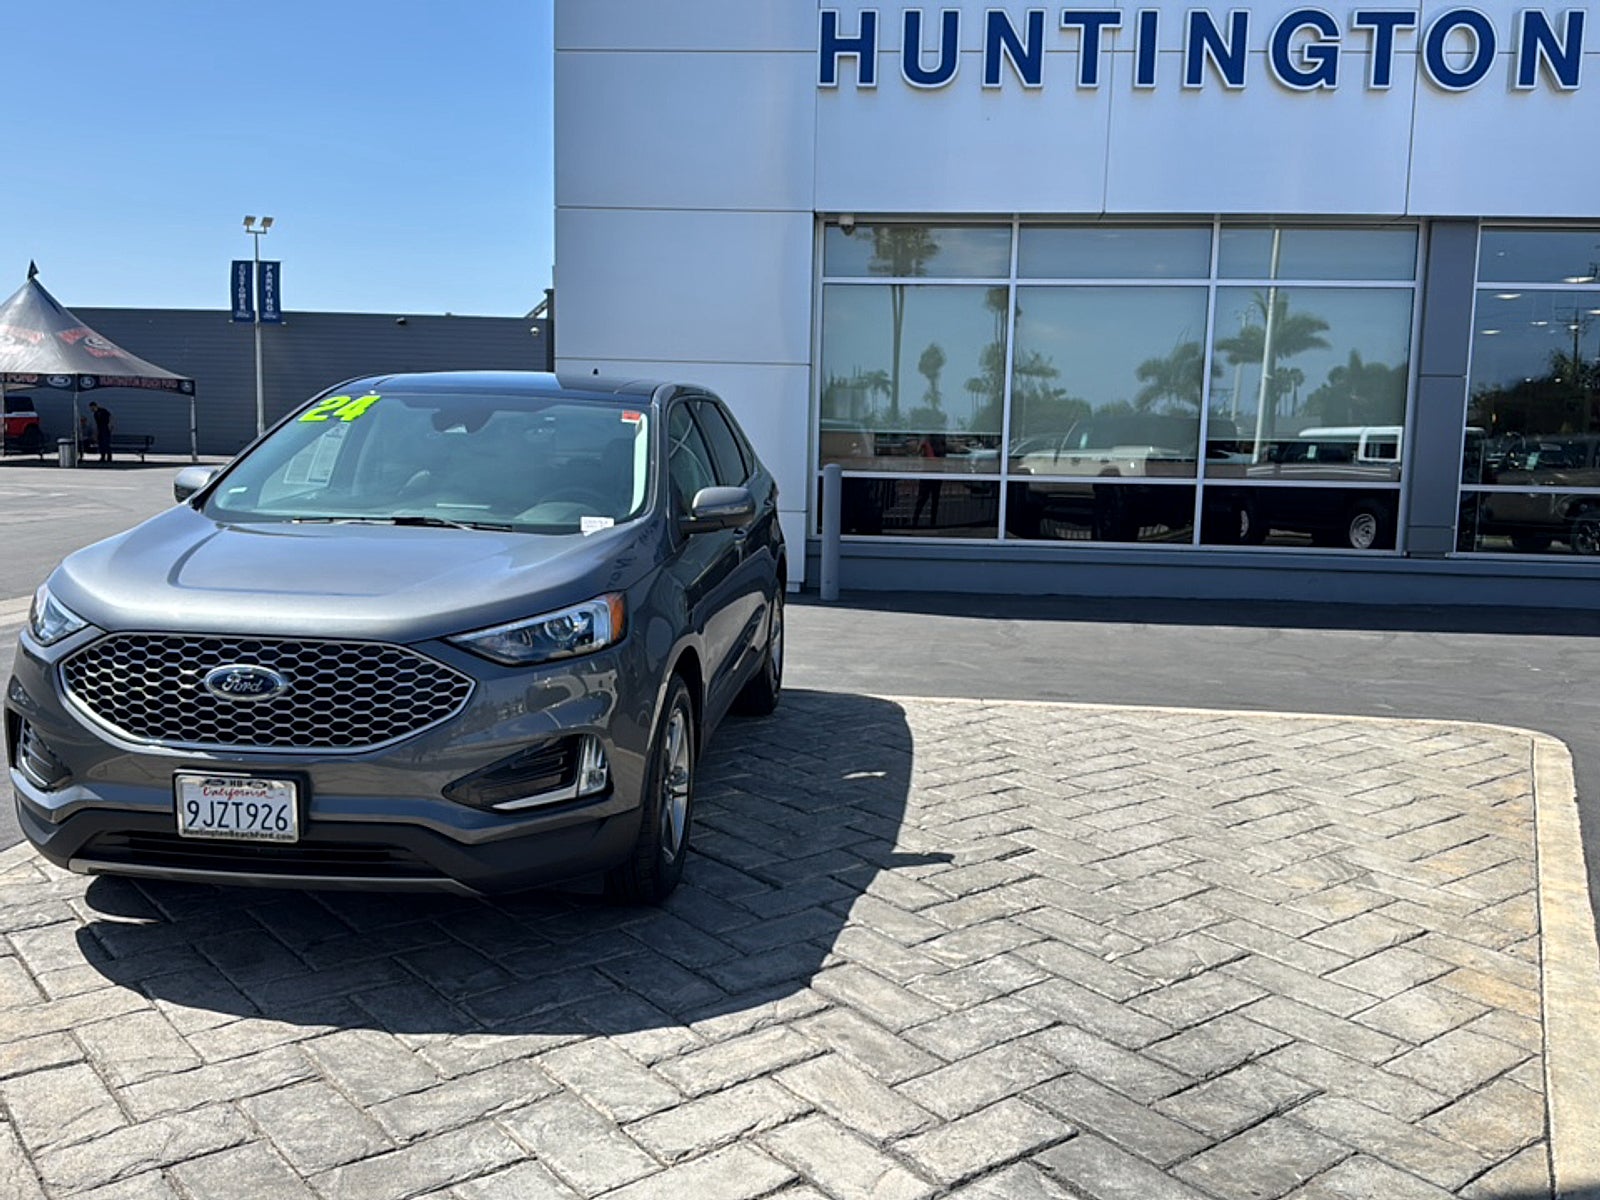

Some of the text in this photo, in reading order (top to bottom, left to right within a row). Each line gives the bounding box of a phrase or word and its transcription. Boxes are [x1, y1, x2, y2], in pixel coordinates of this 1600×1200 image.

[818, 8, 1586, 91] HUNTINGTON
[265, 264, 273, 312] PARKING
[298, 395, 382, 422] 24
[221, 674, 264, 692] Ford
[203, 786, 273, 800] California
[187, 800, 288, 831] 9JZT926
